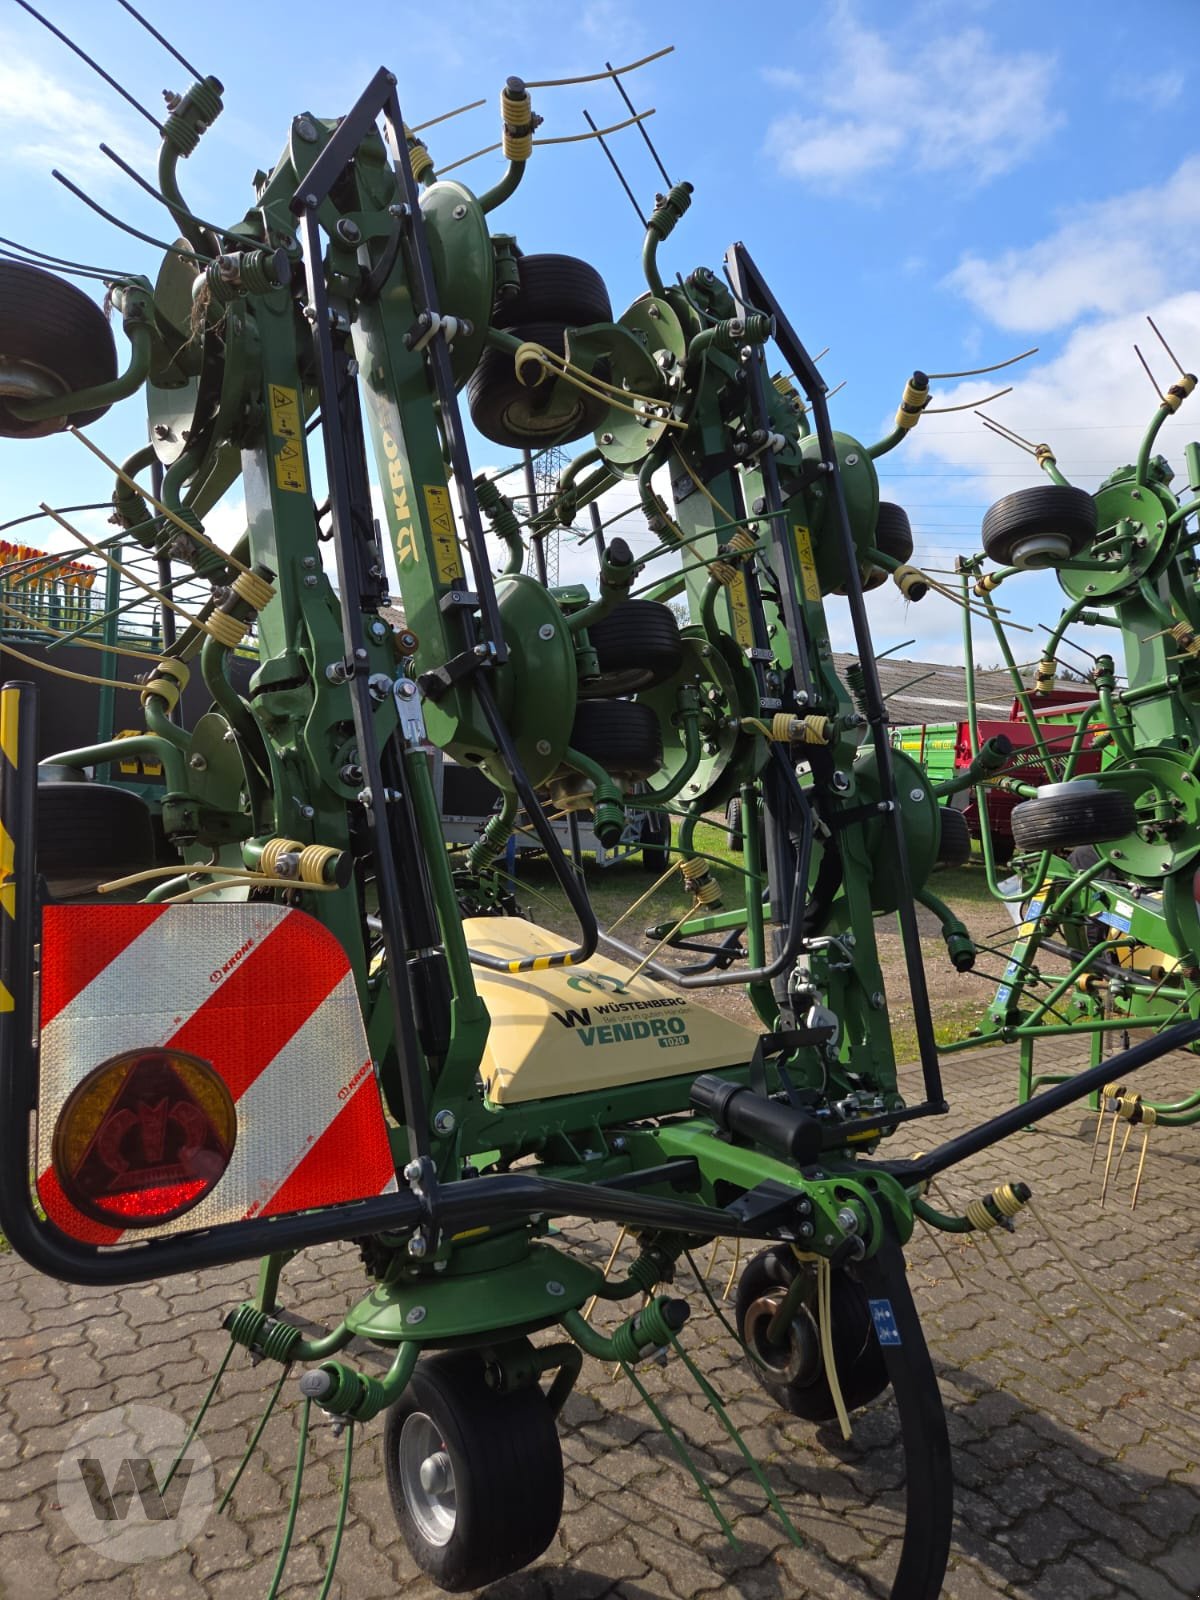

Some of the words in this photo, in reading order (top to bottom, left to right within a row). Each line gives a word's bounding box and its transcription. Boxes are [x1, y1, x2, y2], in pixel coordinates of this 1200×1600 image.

[380, 408, 411, 520] KRO
[222, 938, 254, 973] KRONE
[593, 997, 687, 1015] WÜSTENBERG
[576, 1016, 686, 1047] VENDRO
[662, 1036, 686, 1047] 1020
